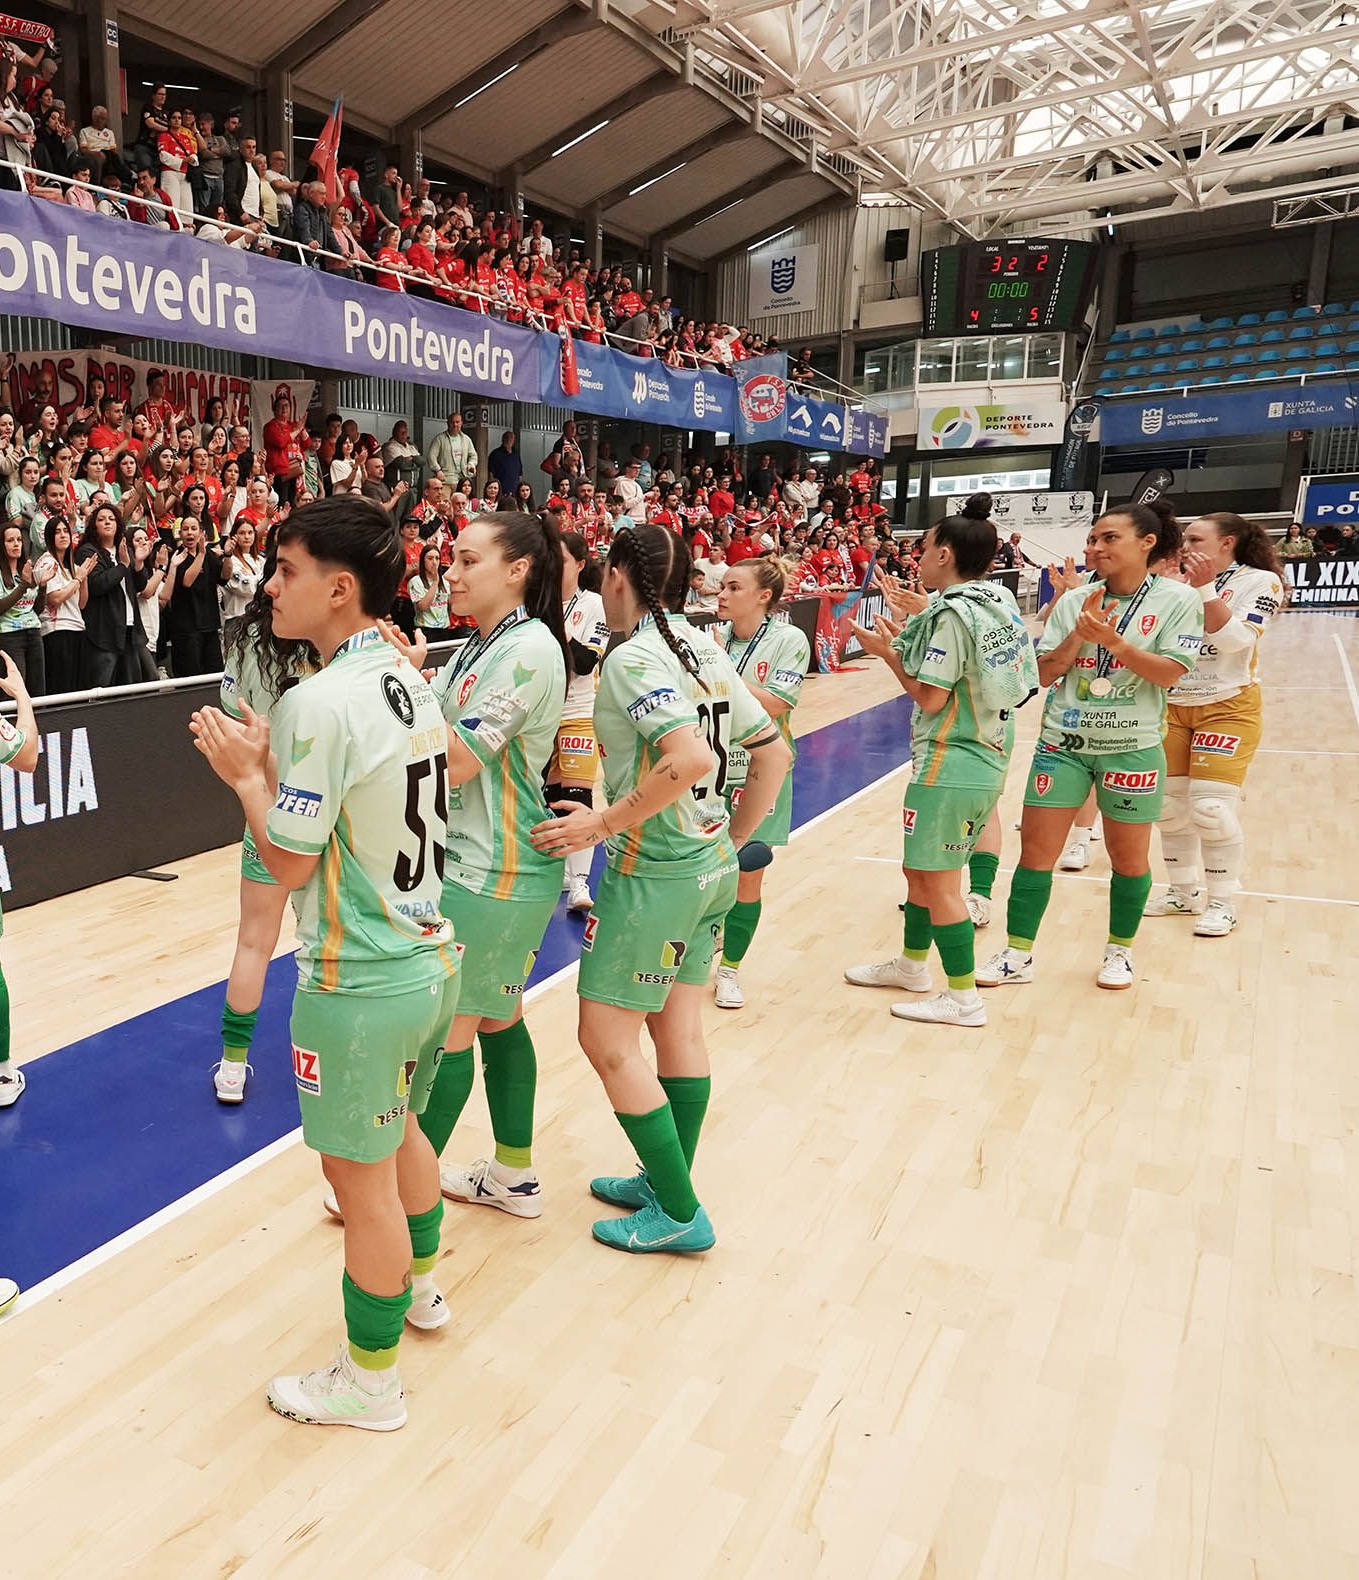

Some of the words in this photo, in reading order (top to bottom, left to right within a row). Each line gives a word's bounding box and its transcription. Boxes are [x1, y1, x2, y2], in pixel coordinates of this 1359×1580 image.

[19, 22, 51, 39] CASTRO
[991, 256, 1002, 272] 3
[1007, 257, 1018, 270] 2
[1037, 254, 1048, 271] 2
[988, 282, 1029, 299] 00:00
[970, 310, 979, 321] 4
[1030, 307, 1039, 321] 5
[343, 300, 515, 387] Pontevedra
[1284, 408, 1297, 416] DE
[1298, 404, 1334, 415] GALICIA
[1285, 400, 1316, 409] XUNTA
[985, 414, 1033, 423] DEPORTE
[1166, 411, 1199, 420] Concello
[1177, 415, 1219, 426] Pontevedra
[985, 421, 1054, 431] PONTEVEDRA
[1317, 504, 1359, 516] PO
[1284, 563, 1311, 587] AL
[1291, 587, 1359, 603] EMININA
[983, 622, 1015, 643] ALEGO
[981, 632, 1017, 653] EPORTE
[221, 677, 236, 693] FER
[1083, 711, 1117, 720] XUNTA
[1081, 720, 1092, 728] DE
[1095, 719, 1139, 728] GALICIA
[1088, 737, 1138, 745] Deputación
[728, 750, 746, 759] NTA
[1104, 770, 1158, 788] FROIZ
[399, 900, 437, 918] ABA
[634, 972, 674, 985] RESER
